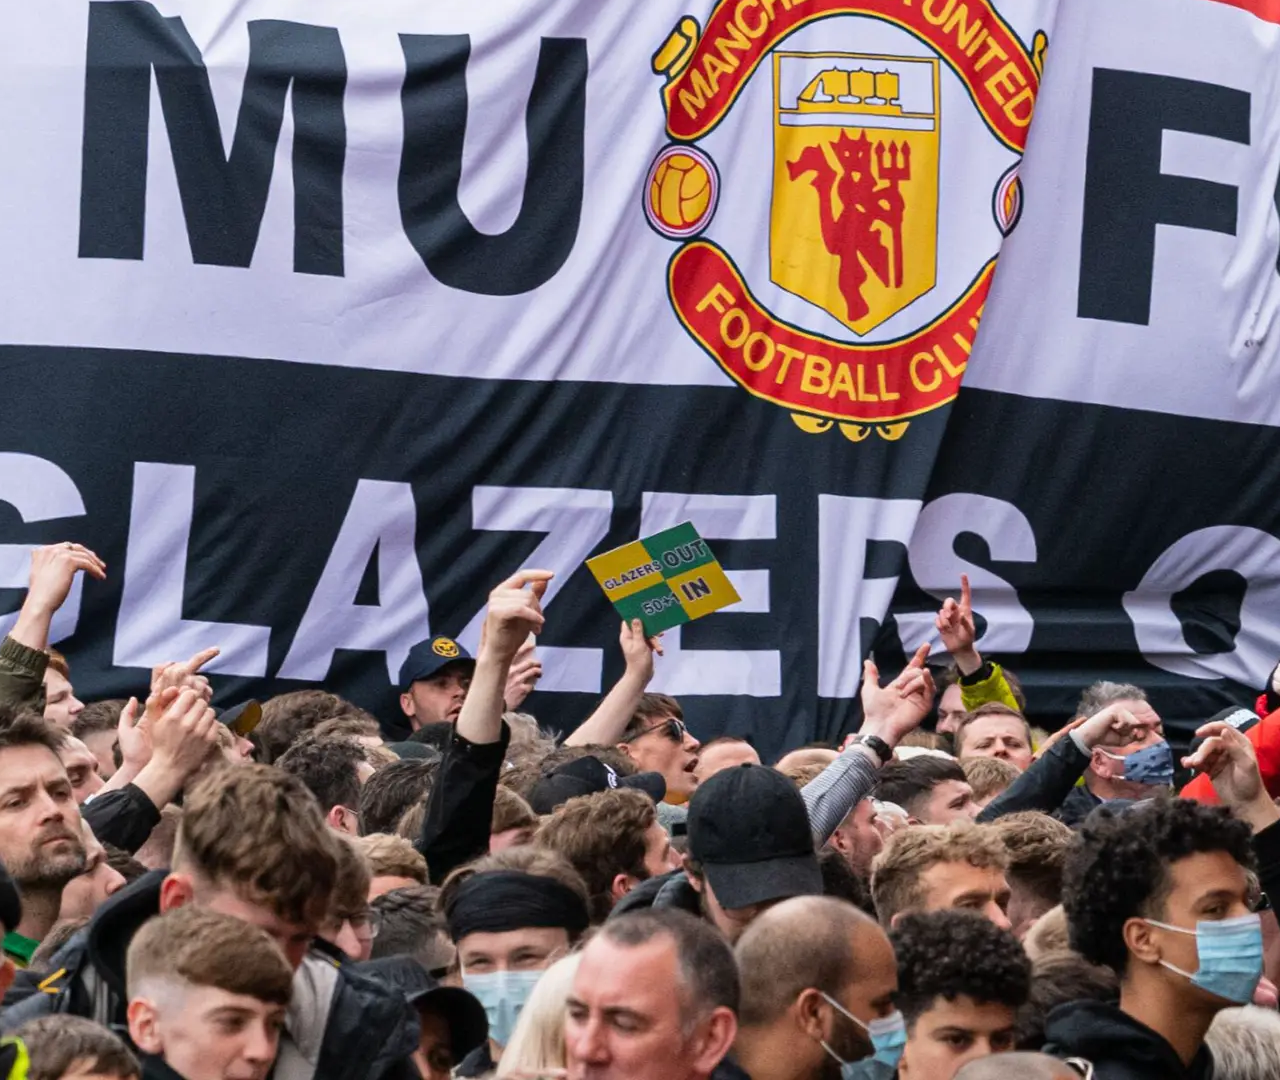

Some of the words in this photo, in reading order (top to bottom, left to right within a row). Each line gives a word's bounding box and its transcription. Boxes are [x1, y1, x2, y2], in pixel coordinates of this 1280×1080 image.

[77, 0, 587, 297] MU
[694, 282, 901, 403] FOOTBALL
[909, 304, 985, 393] CLU
[603, 560, 662, 591] GLAZERS
[662, 539, 707, 568] OUT
[642, 592, 680, 616] 50+1
[680, 577, 713, 602] IN
